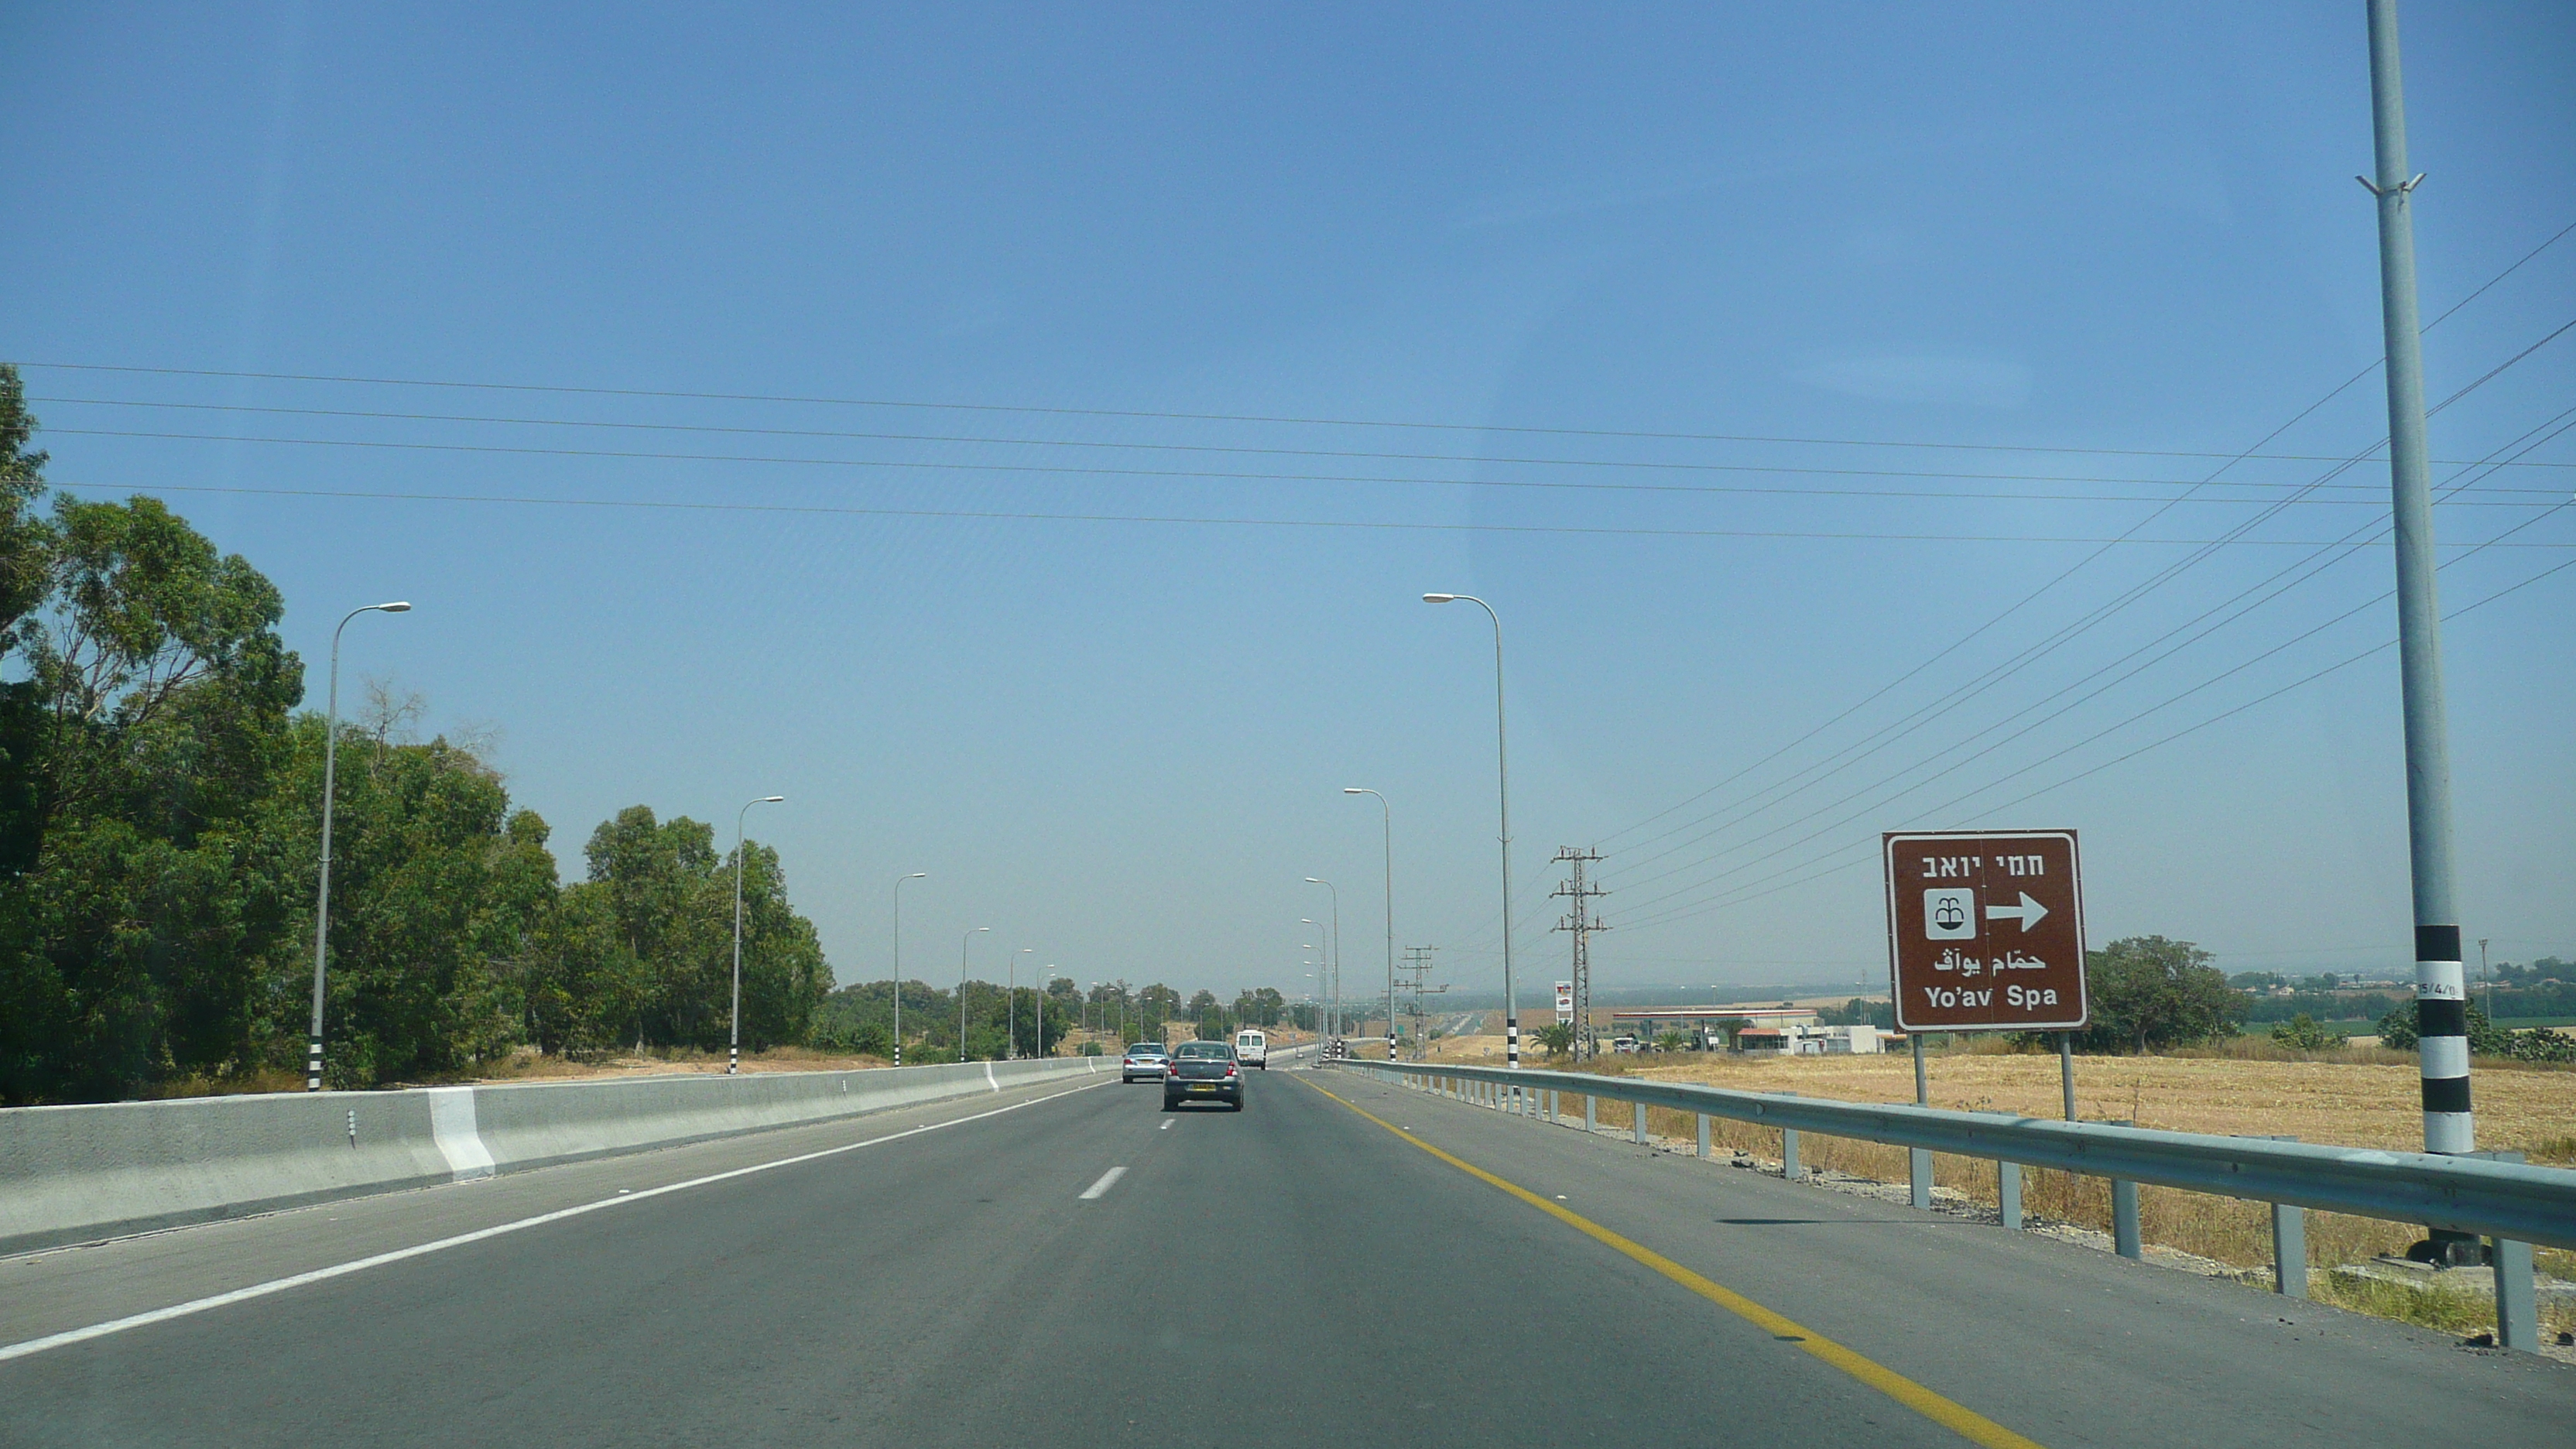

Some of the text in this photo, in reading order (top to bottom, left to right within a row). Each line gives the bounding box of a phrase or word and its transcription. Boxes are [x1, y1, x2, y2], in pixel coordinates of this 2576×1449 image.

[1922, 855, 2044, 879] חמי יואב
[1923, 985, 2057, 1011] Yo'av Spa
